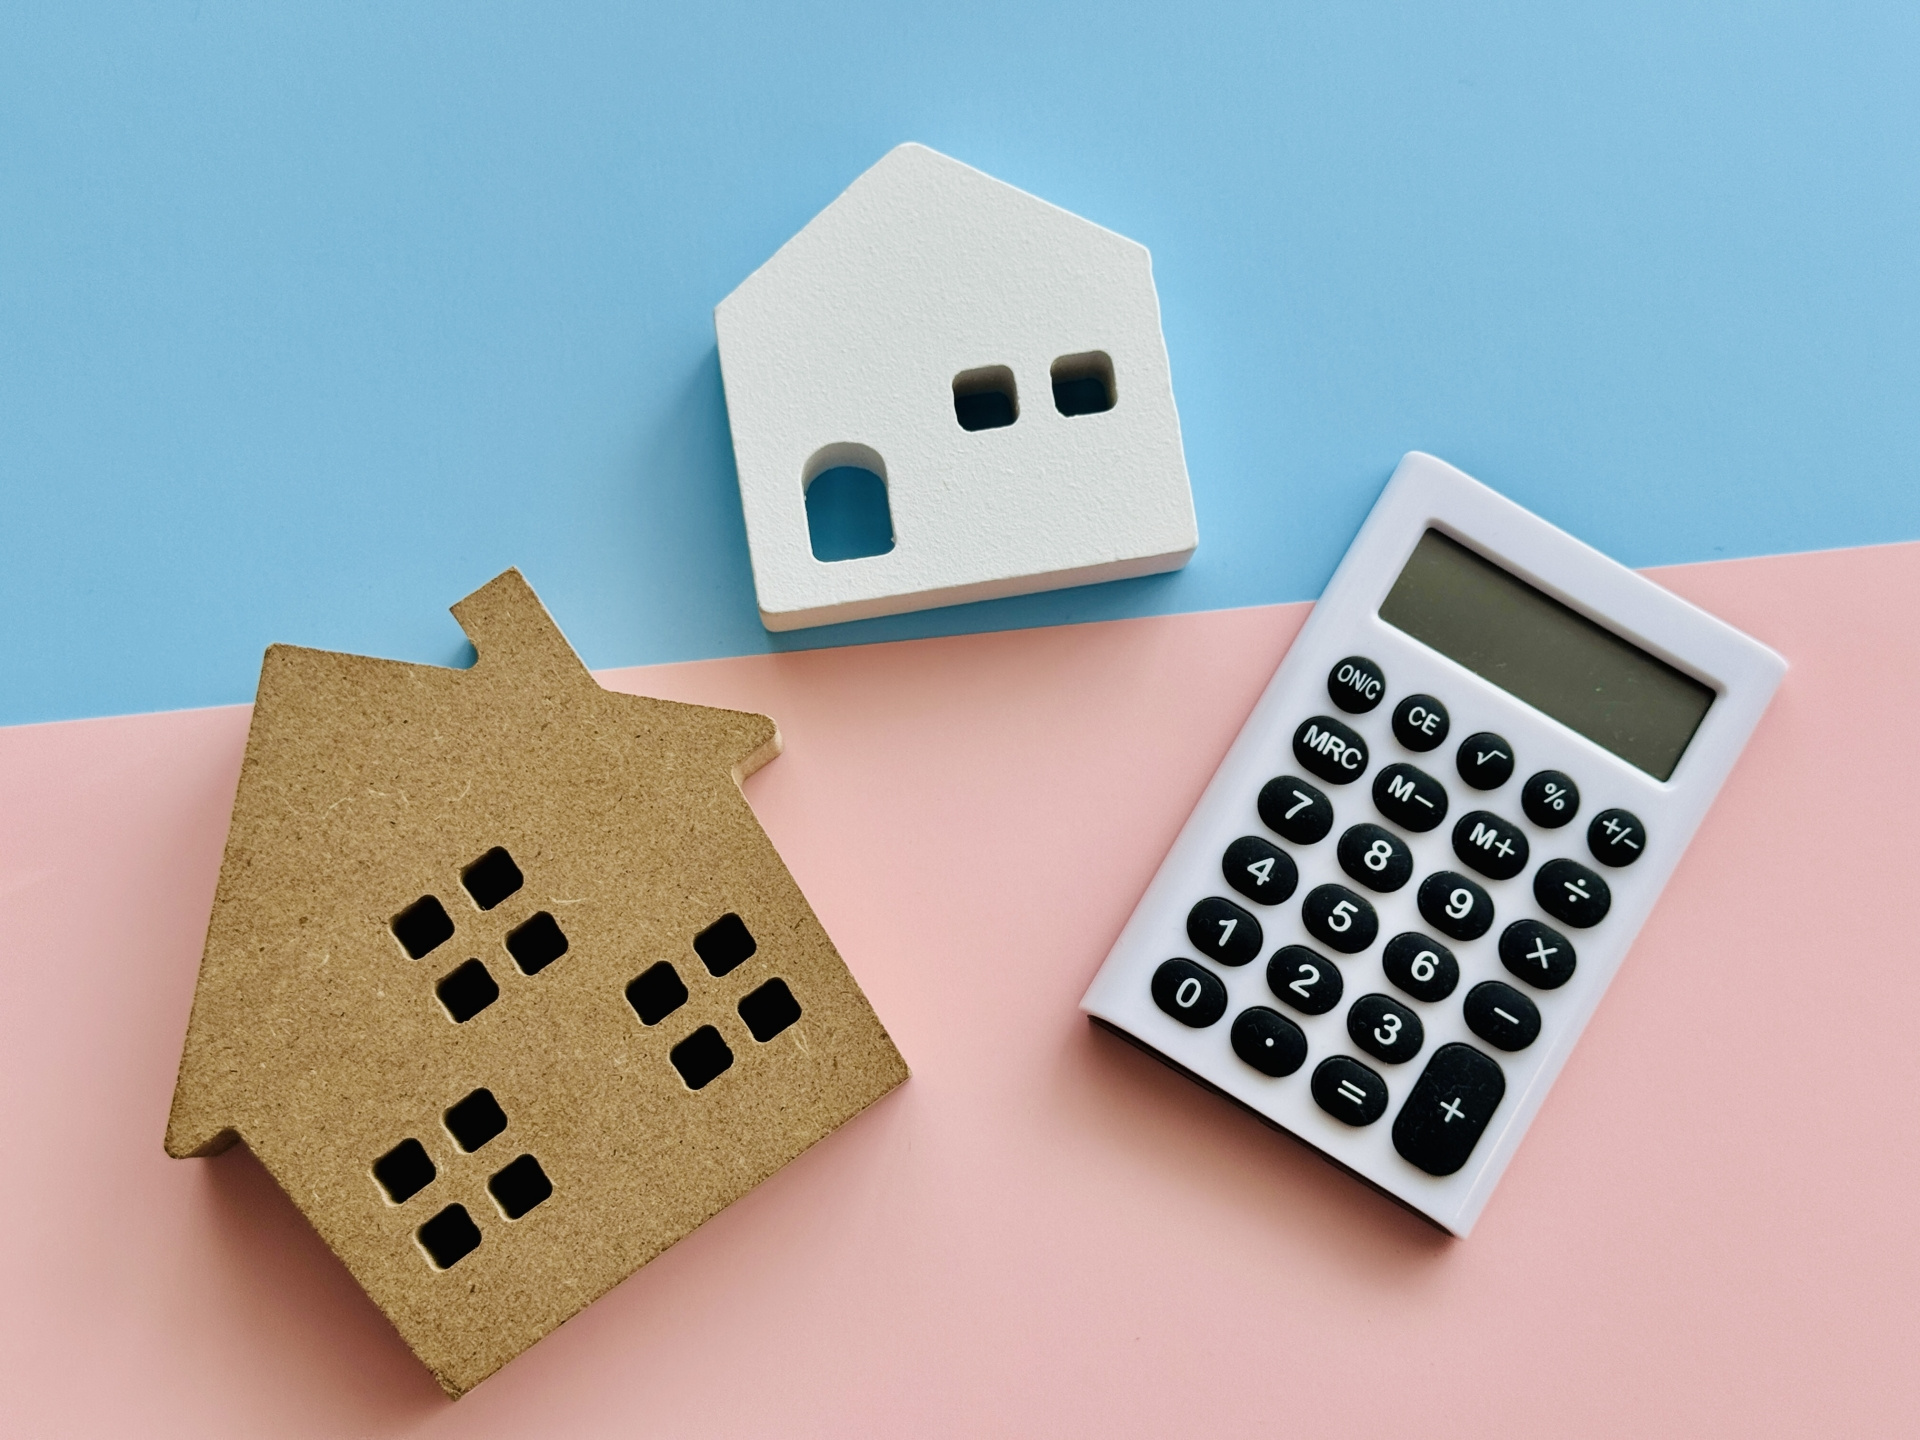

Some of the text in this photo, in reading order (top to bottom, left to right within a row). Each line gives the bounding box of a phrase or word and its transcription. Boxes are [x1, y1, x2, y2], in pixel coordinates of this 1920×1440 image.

[1337, 664, 1381, 700] ON/C
[1408, 706, 1441, 736] CE
[1302, 724, 1363, 770] MRC
[1284, 789, 1314, 820] 7
[1543, 782, 1567, 811] %
[1363, 839, 1393, 871] 8
[1469, 822, 1515, 858] M+
[1246, 857, 1276, 886] 4
[1327, 900, 1359, 932] 5
[1445, 888, 1474, 919] 9
[1218, 918, 1238, 947] 1
[1288, 963, 1321, 998] 2
[1410, 950, 1440, 982] 6
[1175, 977, 1202, 1008] 0
[1373, 1013, 1403, 1046] 3
